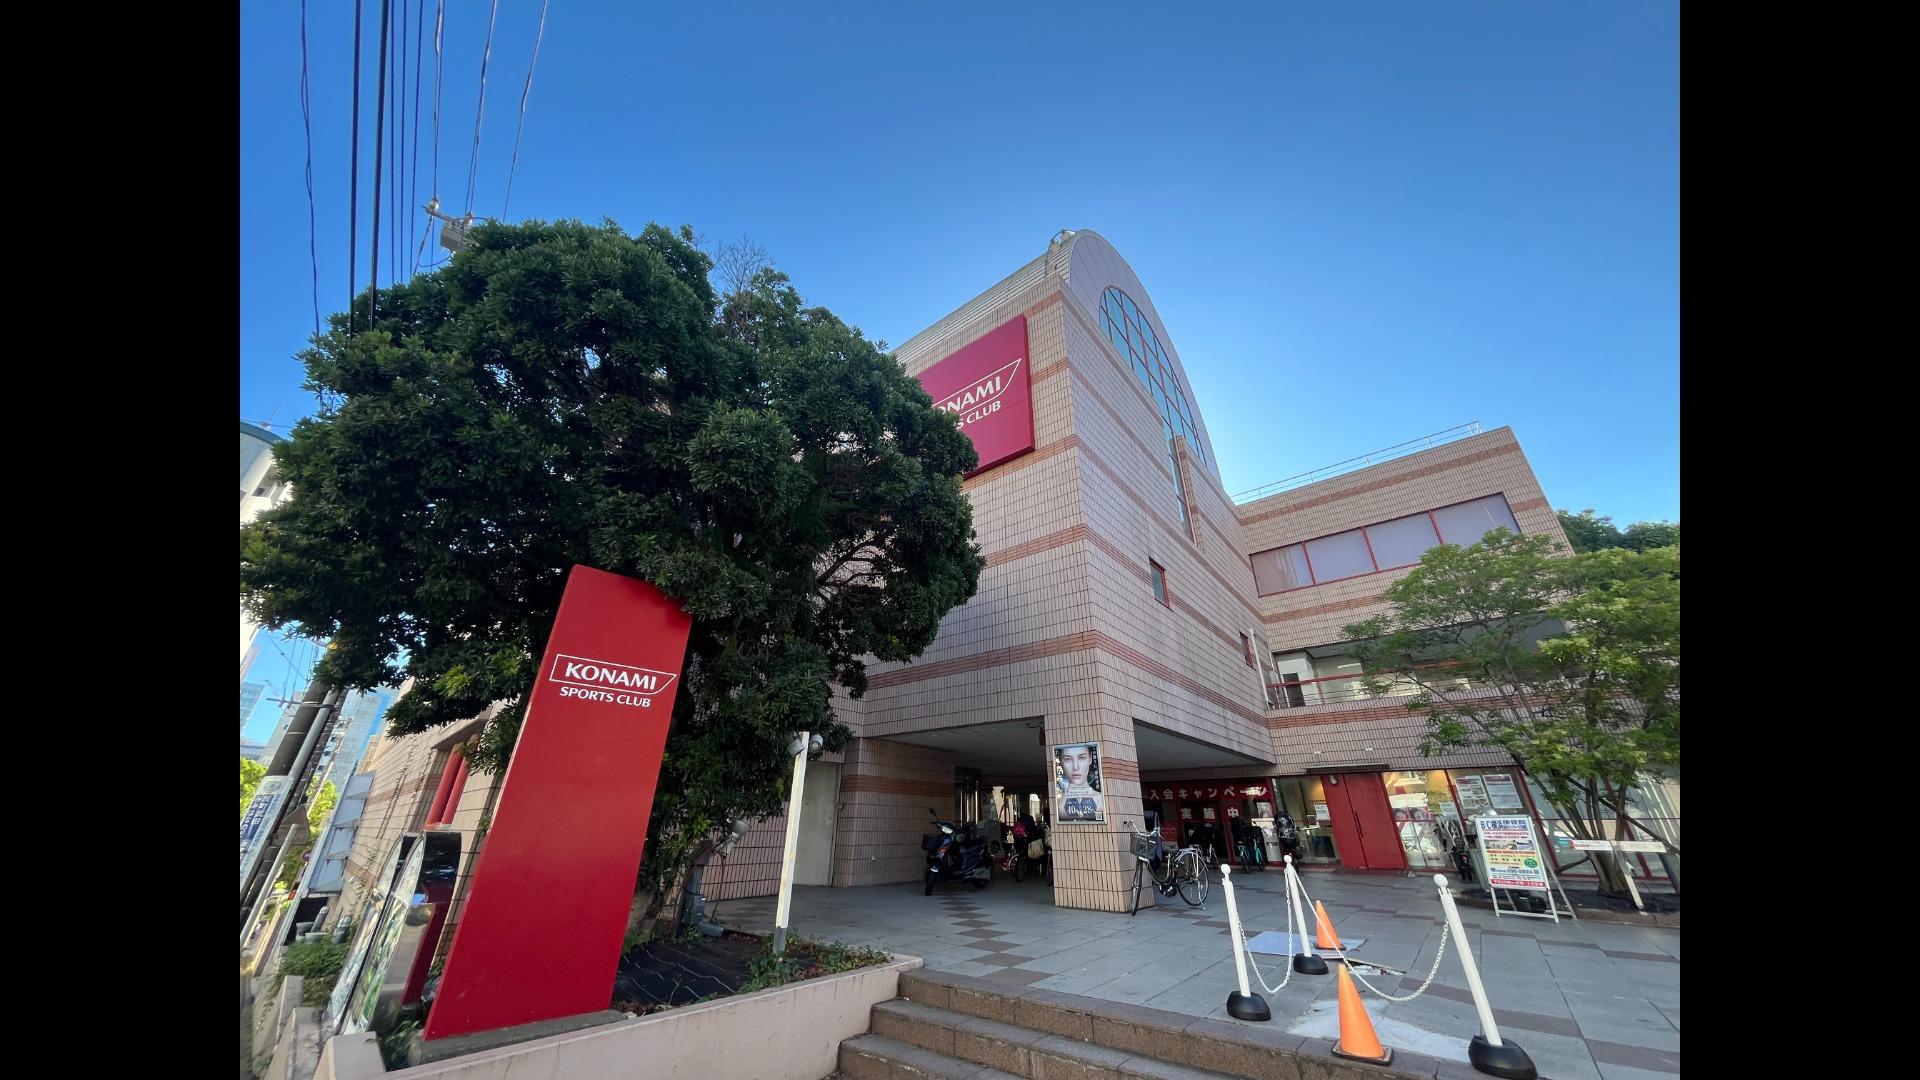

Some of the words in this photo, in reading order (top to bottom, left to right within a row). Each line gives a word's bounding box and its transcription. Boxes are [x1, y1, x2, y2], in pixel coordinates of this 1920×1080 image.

[939, 376, 1001, 415] NAMI
[966, 400, 1001, 424] CLUB
[565, 662, 657, 690] KONAMI
[559, 686, 614, 703] SPORTS
[616, 694, 651, 708] CLUB
[1181, 806, 1239, 819] 実施中
